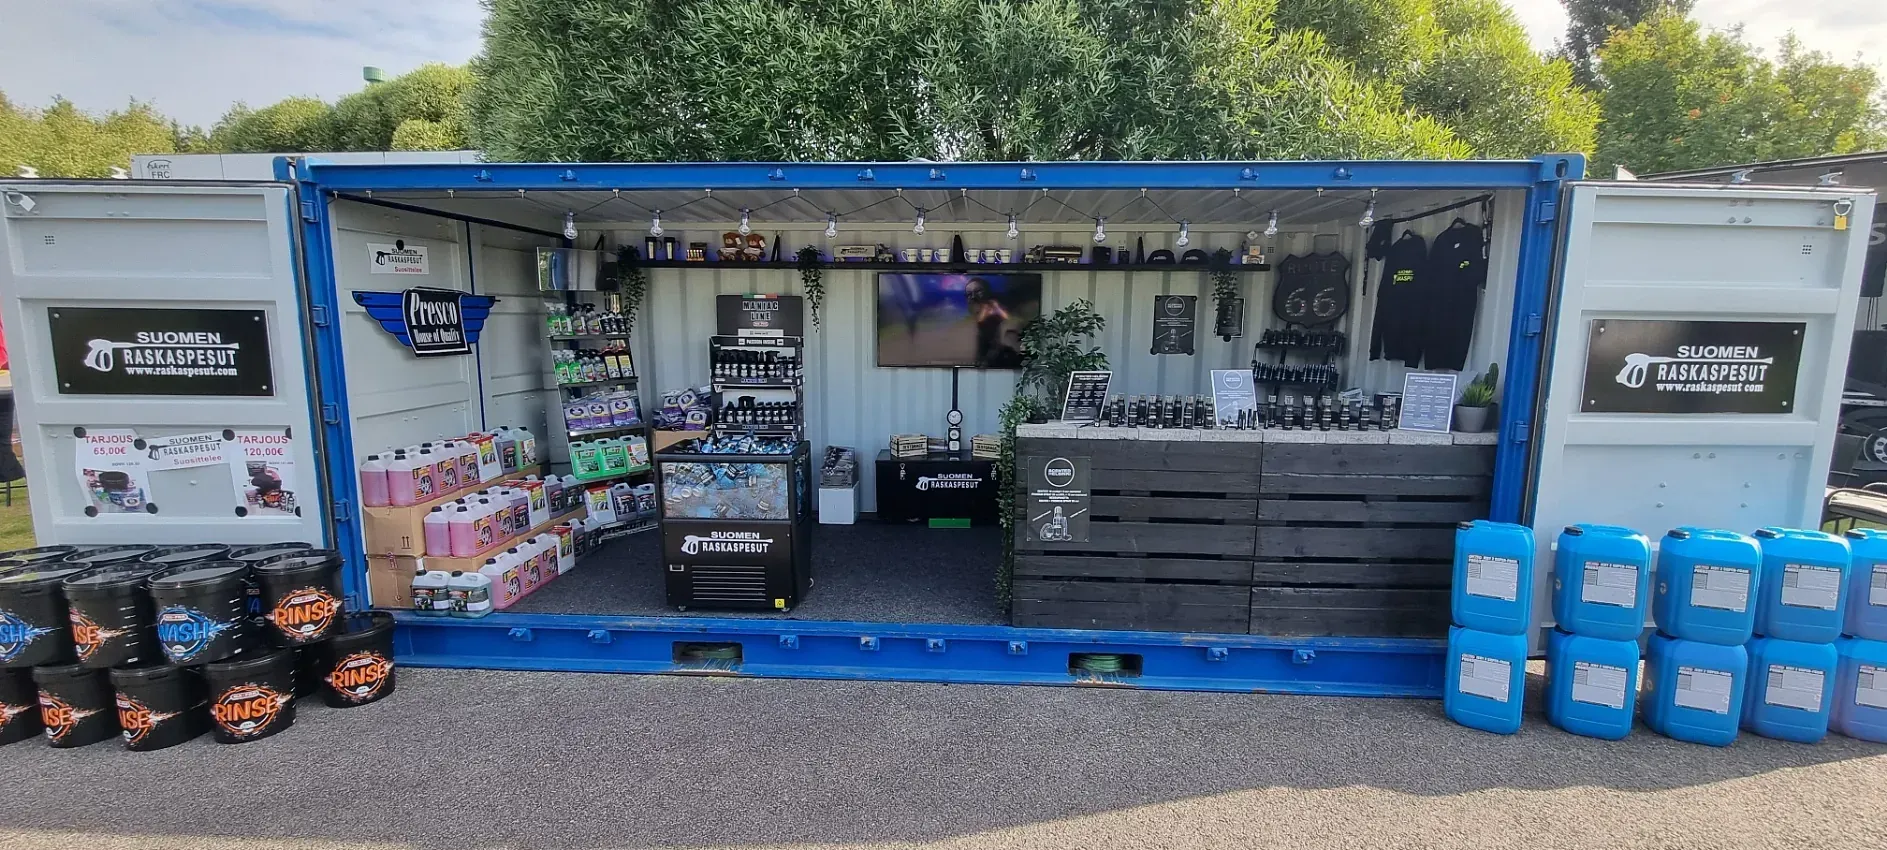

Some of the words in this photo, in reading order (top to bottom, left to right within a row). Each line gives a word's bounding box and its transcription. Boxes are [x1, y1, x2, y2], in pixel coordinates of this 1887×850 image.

[743, 301, 778, 311] MANIAC
[1285, 287, 1336, 317] 66
[410, 293, 458, 326] Presco
[751, 312, 771, 321] LINE
[137, 331, 222, 344] SUOMEN
[413, 329, 433, 343] House
[432, 329, 440, 342] of
[439, 327, 461, 344] Quality
[124, 349, 236, 365] RASKASPESUT
[1677, 345, 1759, 358] SUOMEN
[125, 365, 238, 378] www.raskaspesut.com
[1657, 364, 1768, 381] RASKASPESUT
[85, 434, 134, 445] TARJOUS
[169, 434, 212, 445] SUOMEN
[237, 435, 288, 445] TARJOUS
[93, 446, 127, 456] 65,00€
[163, 443, 222, 456] RASKASPESUT
[244, 447, 284, 456] 120,00€
[173, 455, 222, 465] Suosittelee
[930, 481, 979, 489] RASKASPESUT
[710, 531, 760, 539] SUOMEN
[702, 542, 769, 553] RASKASPESUT
[274, 597, 334, 625] RINSE
[331, 660, 387, 688] RINSE
[215, 693, 279, 722] RINSE
